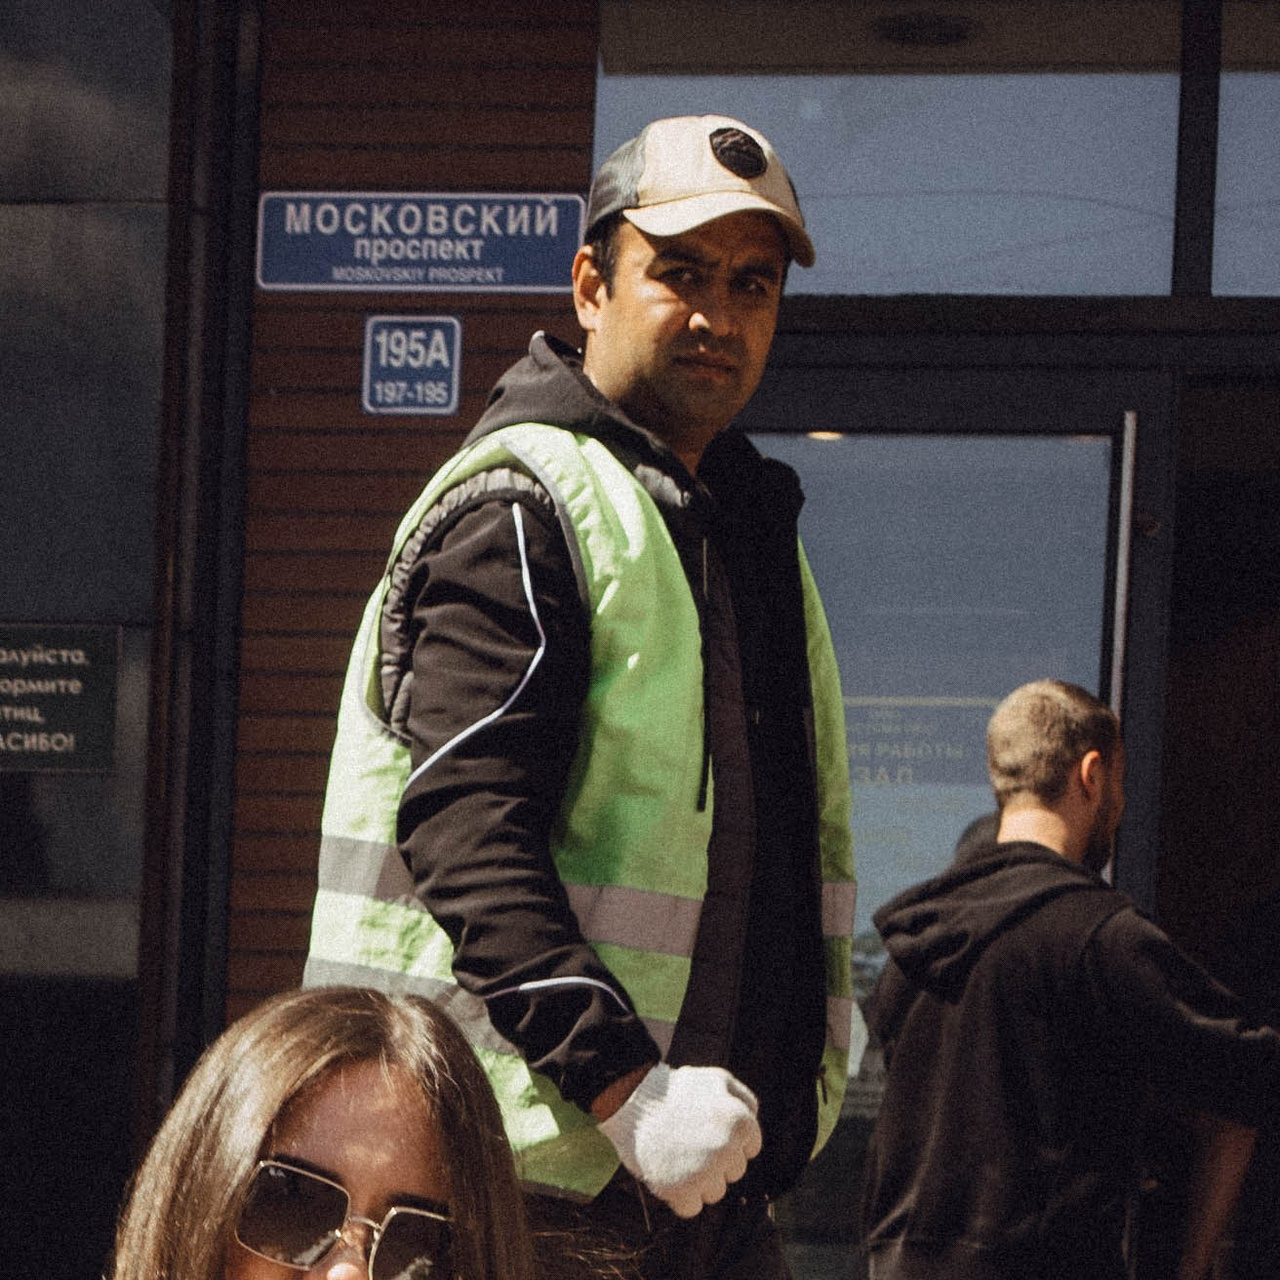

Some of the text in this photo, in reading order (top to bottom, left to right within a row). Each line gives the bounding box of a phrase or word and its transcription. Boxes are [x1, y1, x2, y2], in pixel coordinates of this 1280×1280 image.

[286, 198, 557, 235] МОСКОВСКИЙ
[355, 237, 483, 264] проспект
[428, 267, 504, 283] PROSPEKT
[376, 329, 448, 367] 195А
[375, 381, 446, 403] 197-195
